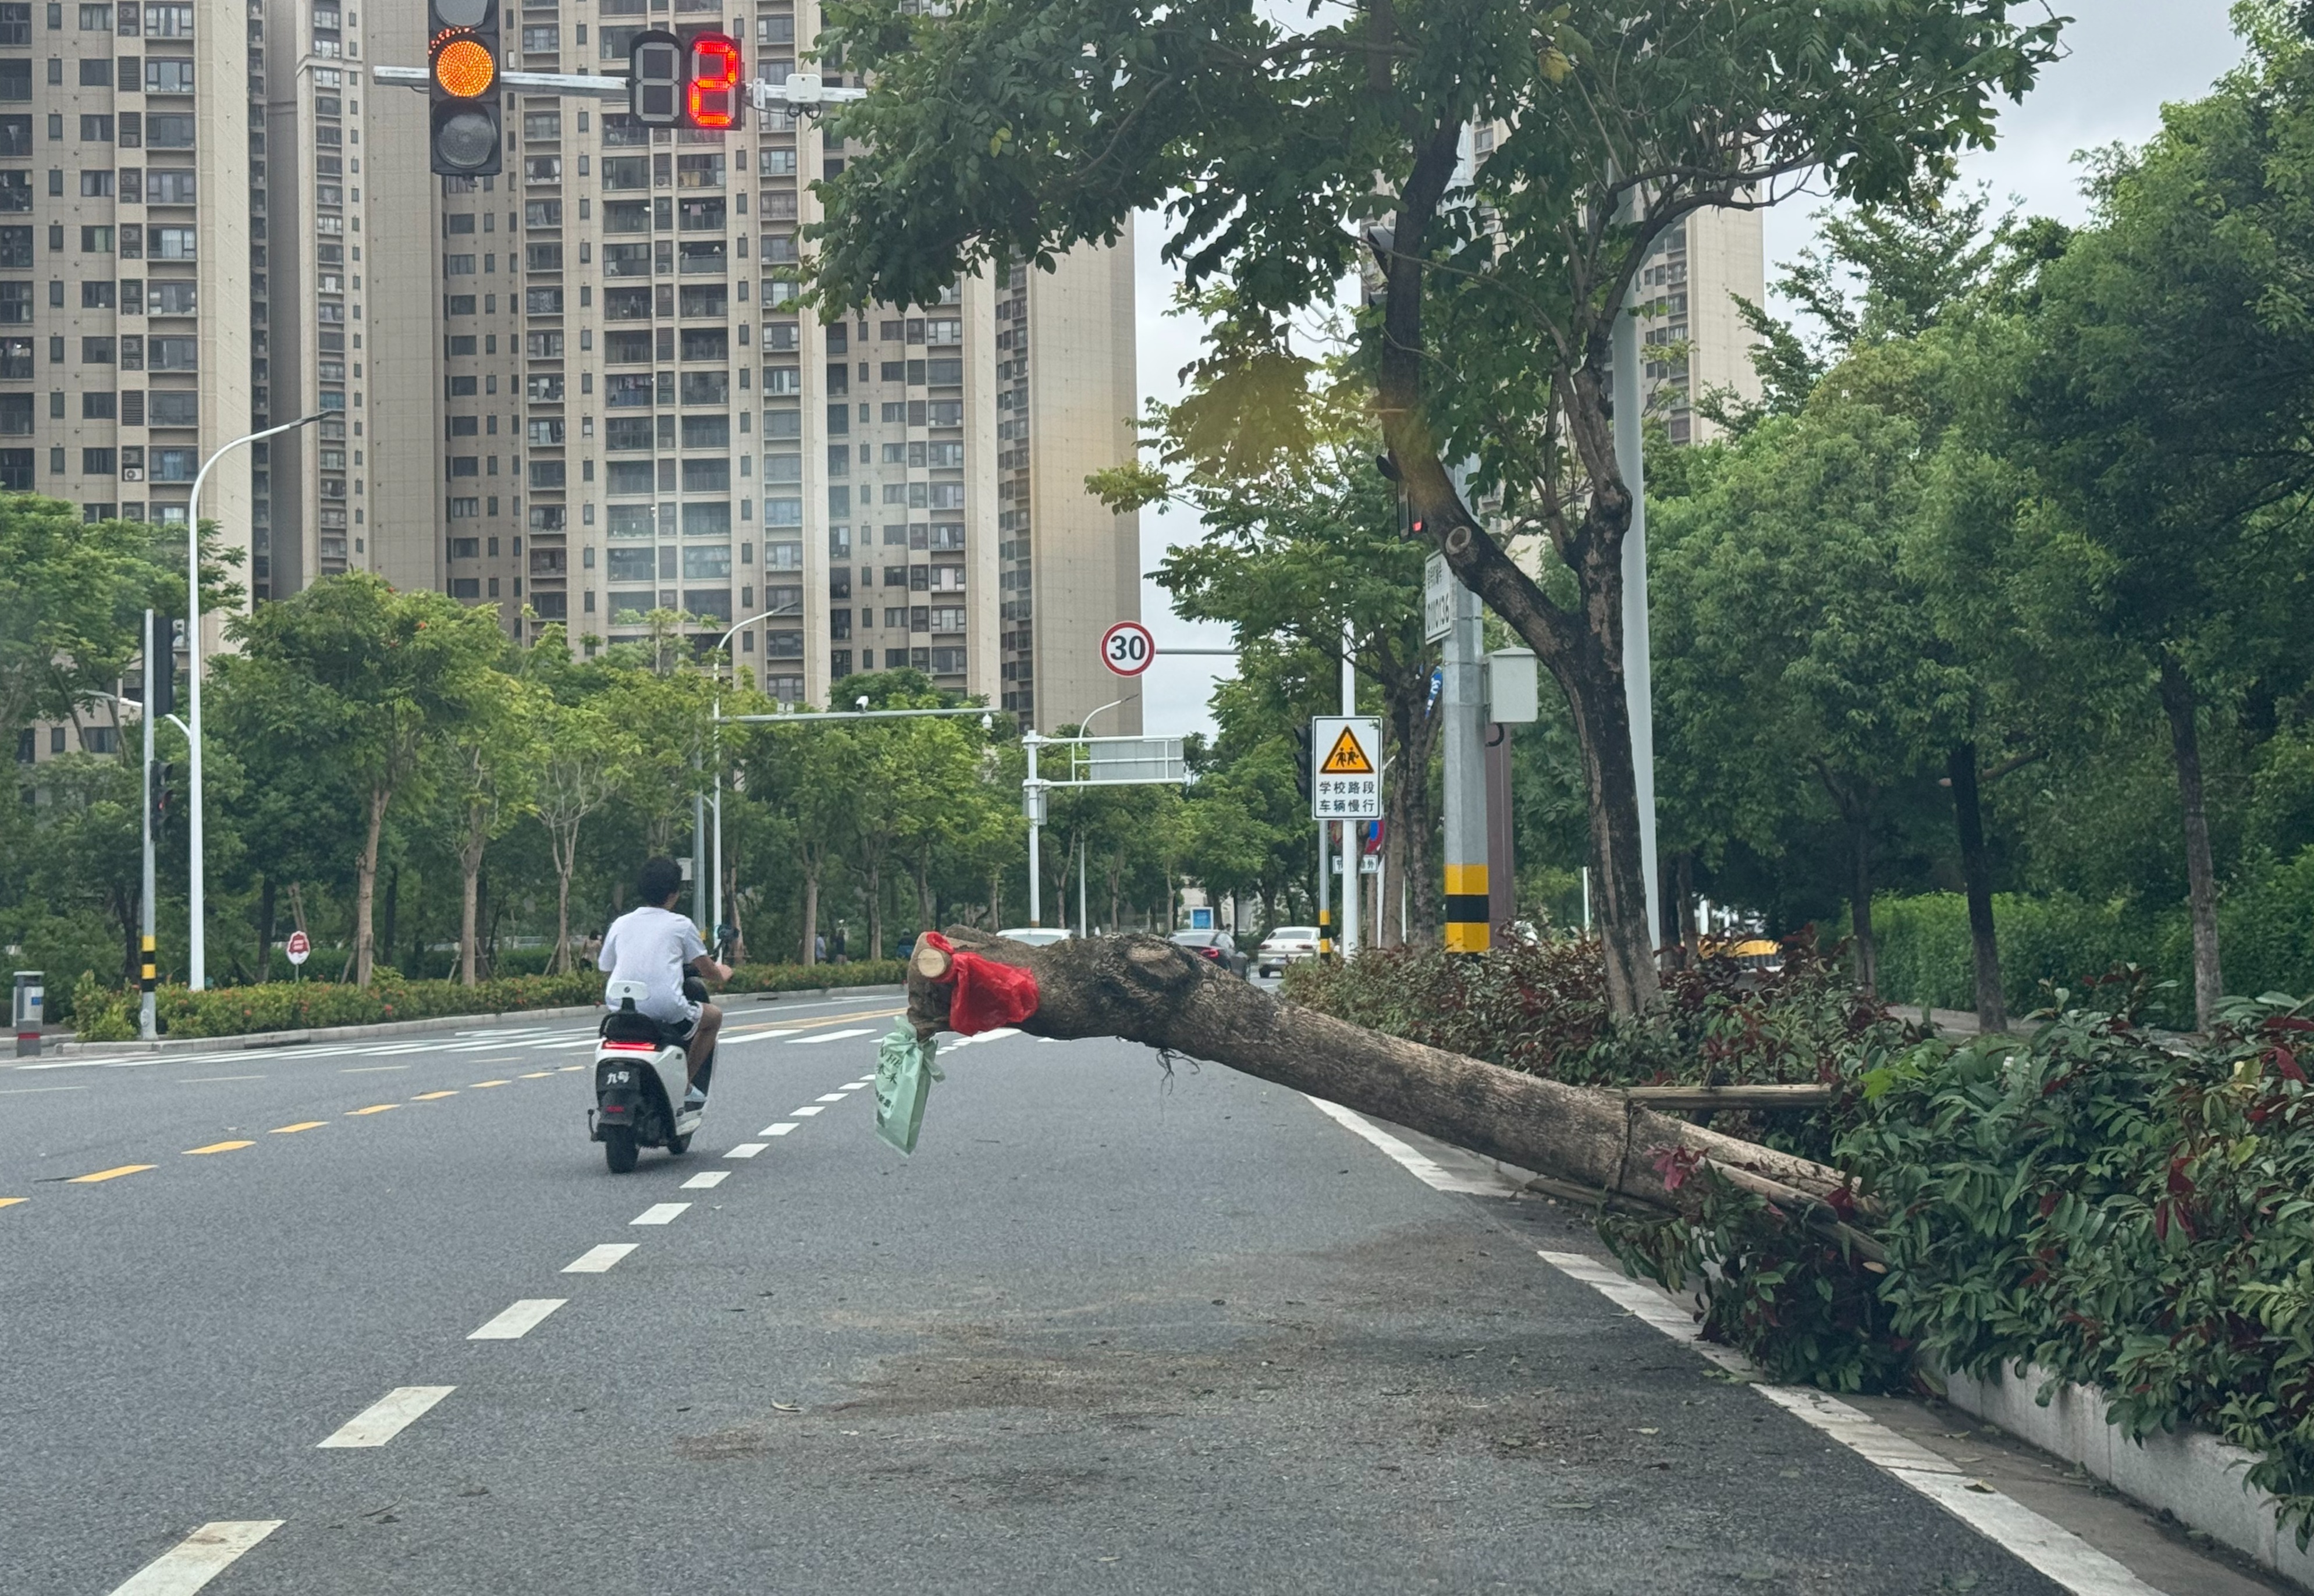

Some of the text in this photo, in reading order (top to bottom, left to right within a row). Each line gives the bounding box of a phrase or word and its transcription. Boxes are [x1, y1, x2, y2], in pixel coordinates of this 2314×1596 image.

[689, 41, 737, 126] 2
[1110, 635, 1146, 660] 30
[1319, 781, 1374, 794] 学校路段
[1319, 799, 1374, 812] 车辆慢行
